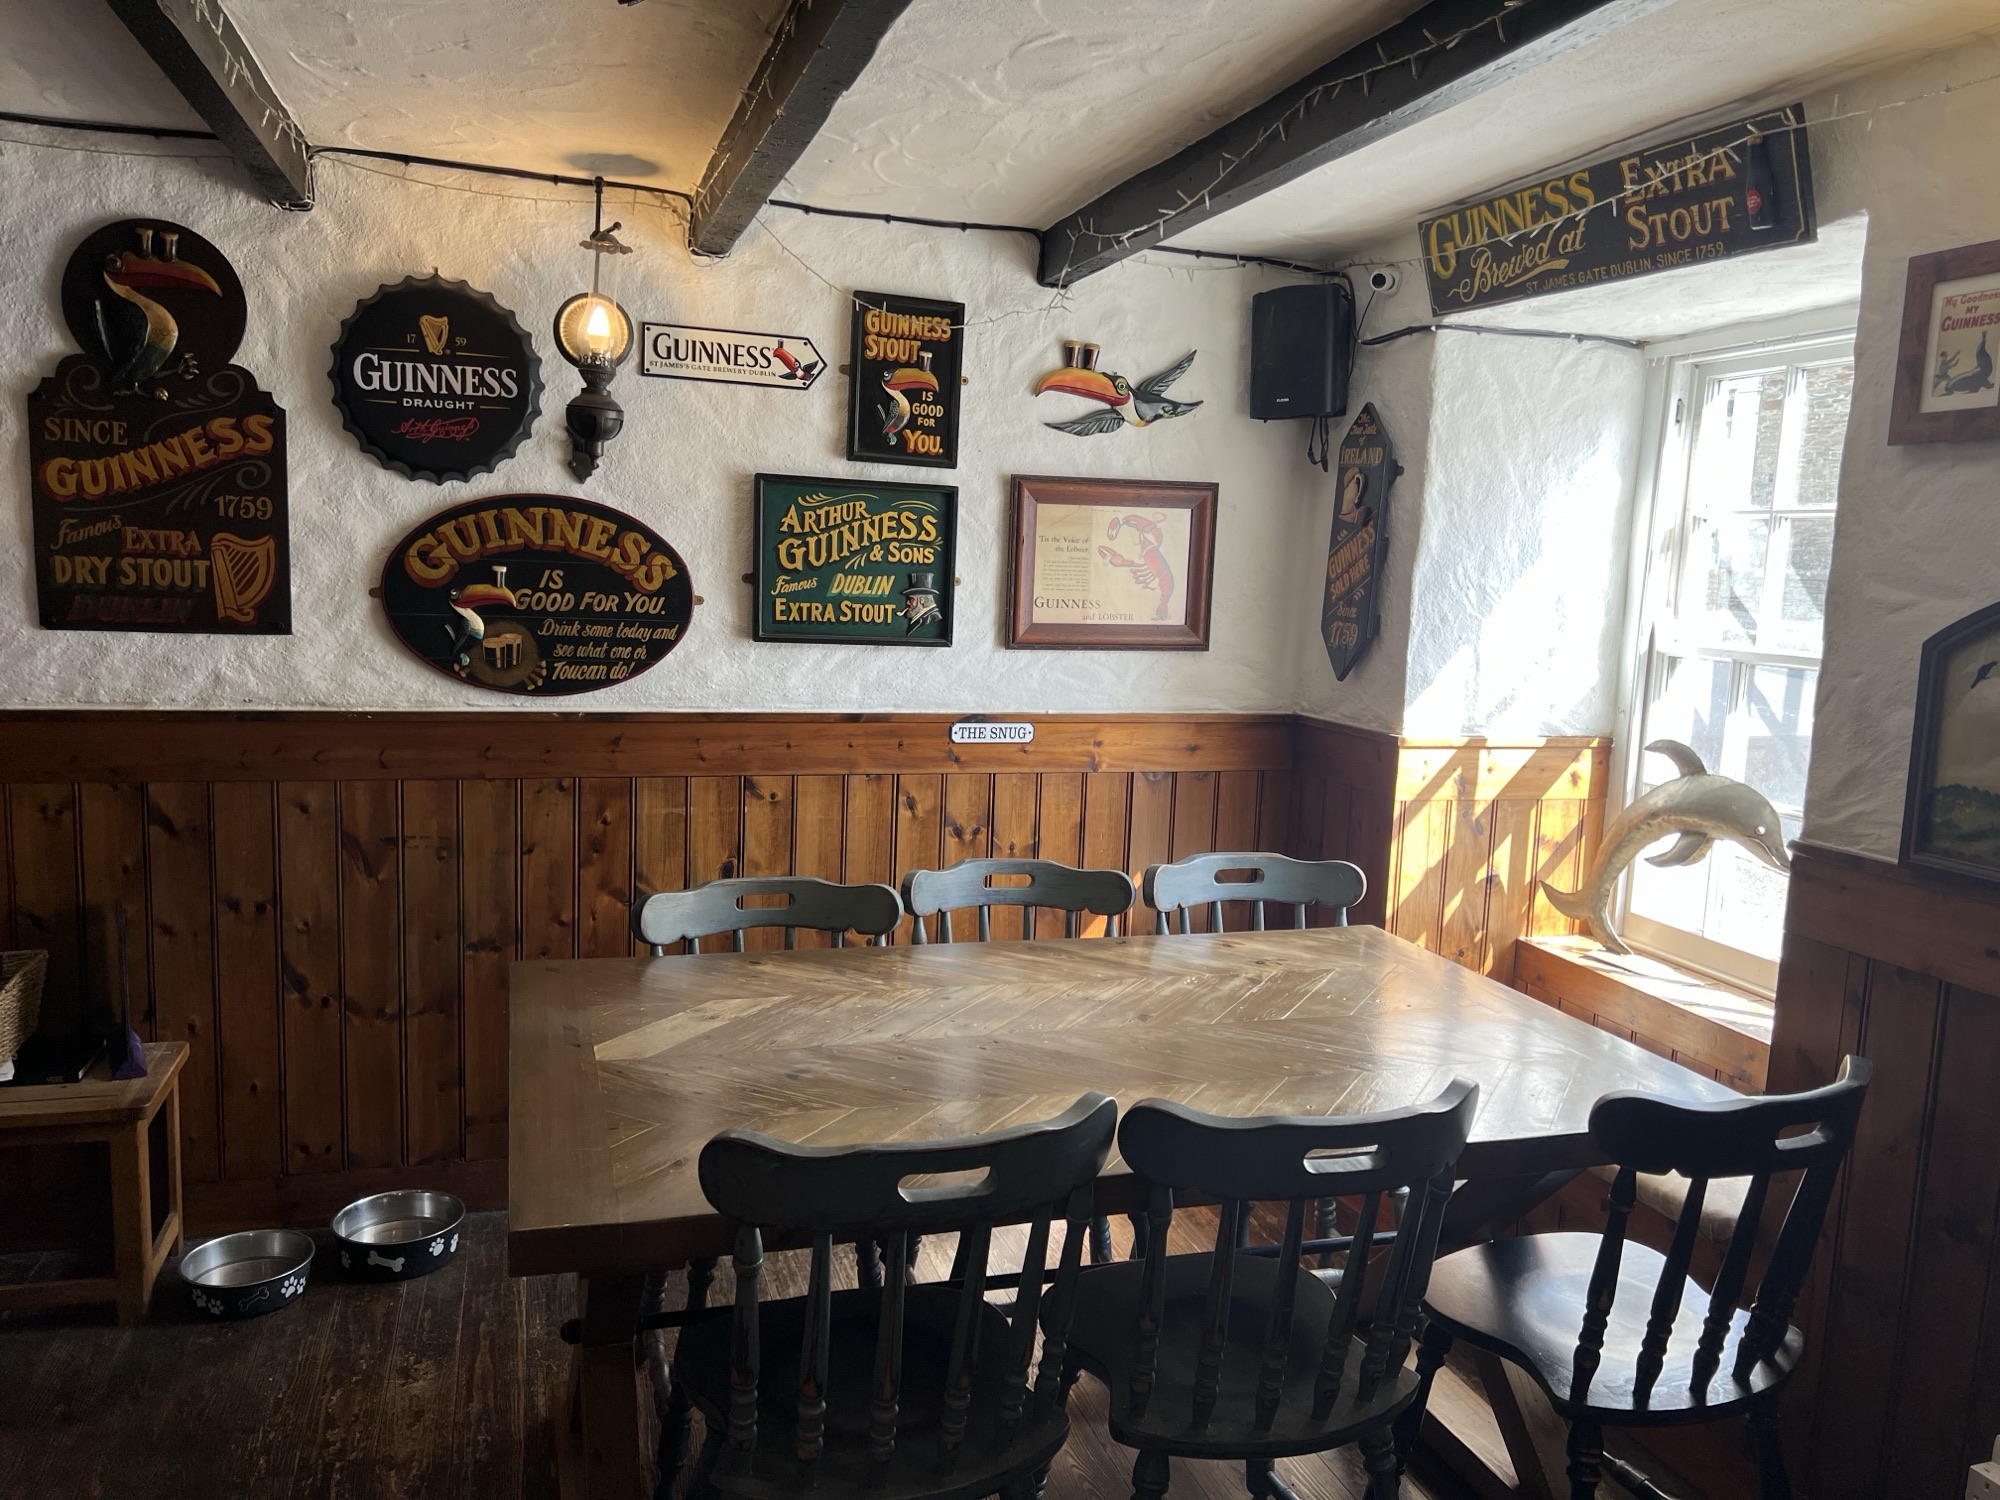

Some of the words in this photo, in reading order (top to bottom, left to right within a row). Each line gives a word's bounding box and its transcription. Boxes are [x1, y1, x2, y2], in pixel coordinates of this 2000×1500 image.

[1620, 147, 1736, 205] EXTRA
[1429, 171, 1594, 279] GUINNESS
[1626, 196, 1734, 250] STOUT
[1447, 230, 1554, 302] Brewed
[1558, 218, 1586, 254] at
[1577, 266, 1608, 283] GATE
[1656, 249, 1692, 268] SINCE
[1941, 312, 2000, 331] GUINNESS
[1965, 305, 1979, 315] MY
[865, 309, 952, 342] GUINNESS
[406, 334, 416, 344] 17
[455, 337, 467, 348] 59
[652, 332, 773, 369] GUINNESS
[864, 334, 922, 363] STOUT
[352, 352, 519, 400] GUINNESS
[660, 361, 690, 370] JAMES'S
[691, 364, 711, 372] GATE
[712, 366, 747, 375] BREWERY
[748, 369, 777, 377] DUBLIN
[403, 398, 476, 411] DRAUGHT
[912, 402, 944, 418] GOOD
[922, 391, 934, 402] IS
[44, 417, 128, 446] SINCE
[917, 417, 936, 428] FOR
[902, 428, 944, 455] YOU.
[1340, 446, 1383, 464] IRELAND
[42, 414, 275, 501] GUINNESS
[214, 495, 273, 521] 1759
[779, 501, 872, 535] ARTHUR
[50, 514, 122, 550] Famous
[123, 526, 203, 557] EXTRA
[778, 511, 938, 571] GUINNESS
[1063, 536, 1080, 544] Voice
[1082, 536, 1089, 544] of
[404, 506, 679, 595] GUINNESS
[869, 544, 884, 562] &
[887, 542, 935, 565] SONS
[1328, 521, 1375, 579] GUINNESS
[53, 554, 113, 586] DRY
[119, 556, 211, 588] STOUT
[539, 569, 564, 590] IS
[1330, 572, 1350, 600] SOLD
[1349, 553, 1370, 583] HERE
[770, 574, 819, 596] Famous
[827, 572, 896, 598] DUBLIN
[514, 588, 575, 612] GOOD
[579, 591, 619, 612] FOR
[623, 591, 666, 615] YOU.
[775, 597, 836, 623] EXTRA
[839, 599, 896, 624] STOUT
[1034, 596, 1101, 609] GUINNESS
[1081, 612, 1095, 621] and
[1098, 613, 1134, 621] LOBSTER
[537, 618, 581, 637] Drink
[581, 623, 614, 638] some
[616, 622, 653, 643] today
[652, 623, 679, 641] and
[1328, 621, 1358, 647] 1759
[553, 643, 575, 658] see
[576, 641, 609, 659] what
[610, 644, 632, 659] one
[633, 644, 648, 660] or
[552, 661, 608, 681] Toucan
[609, 661, 636, 680] do!
[958, 726, 987, 739] THE
[990, 726, 1027, 739] SNUG
